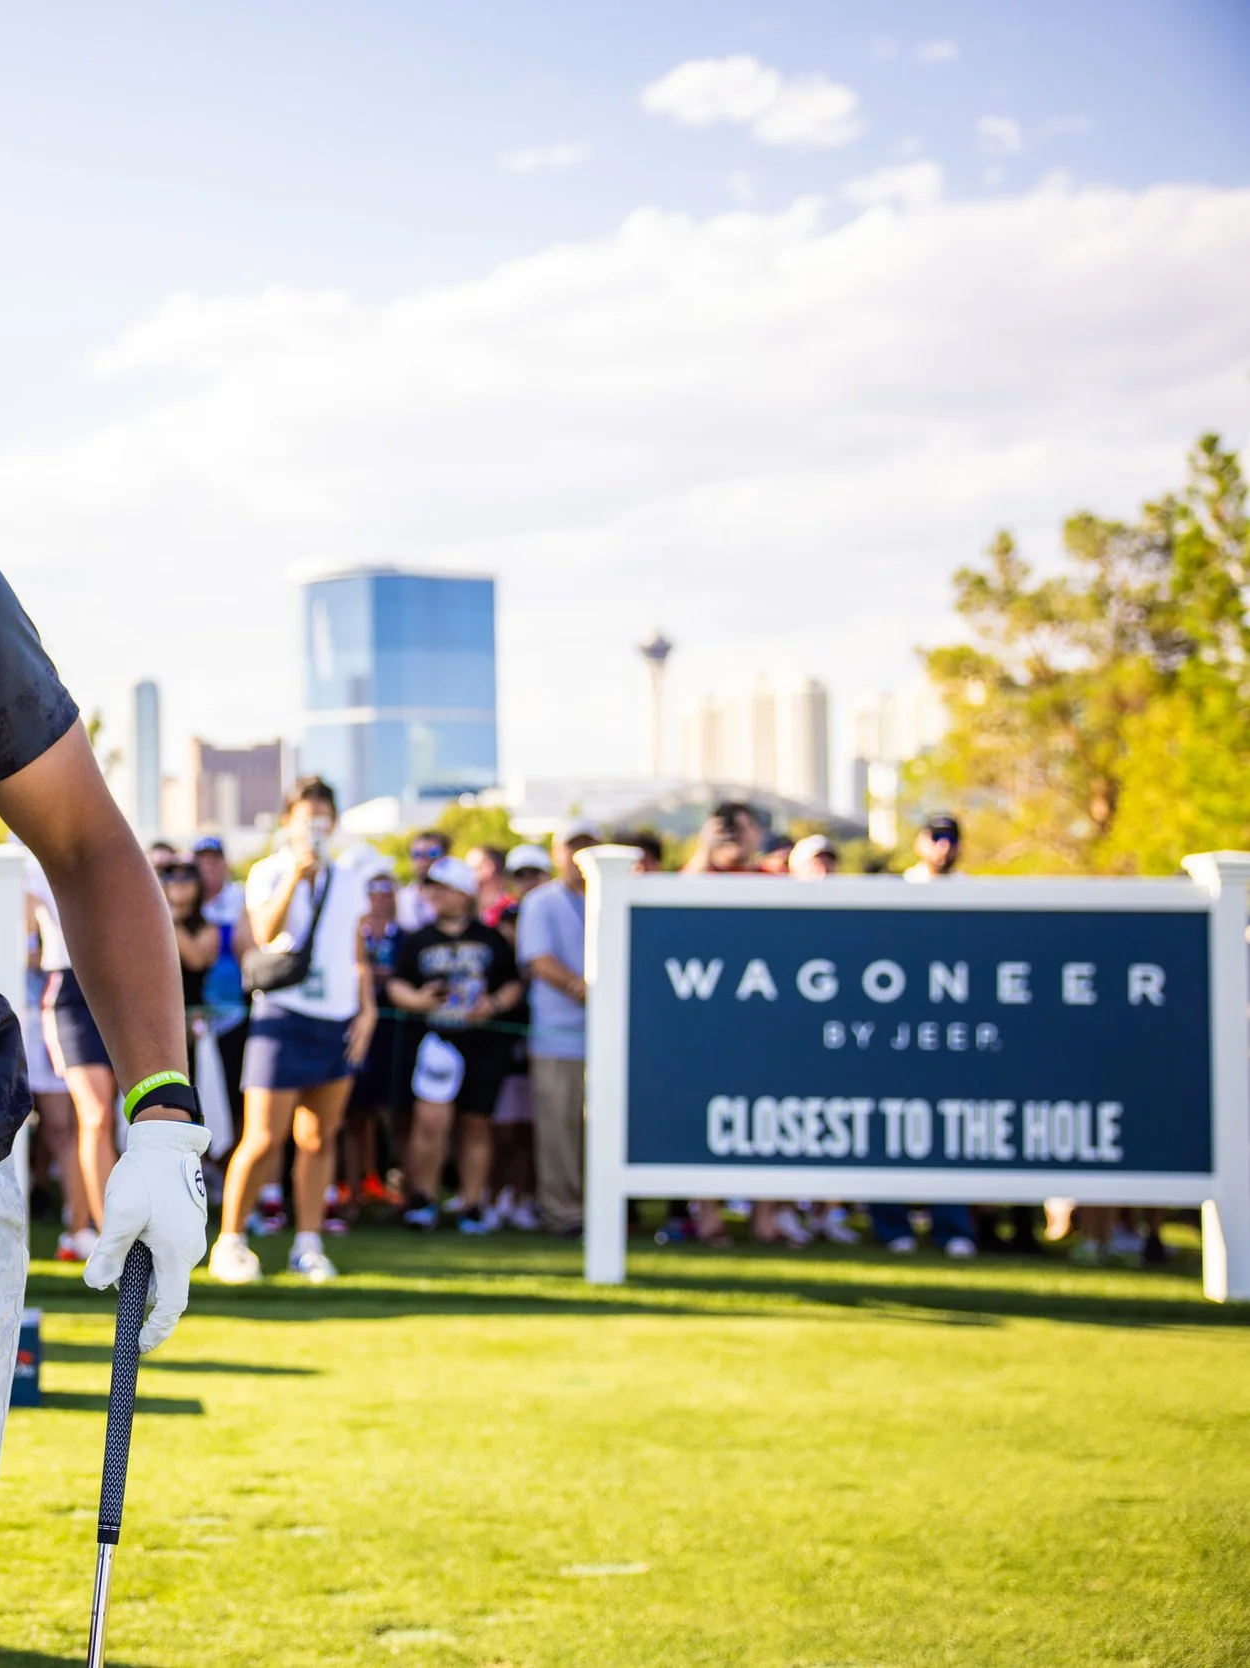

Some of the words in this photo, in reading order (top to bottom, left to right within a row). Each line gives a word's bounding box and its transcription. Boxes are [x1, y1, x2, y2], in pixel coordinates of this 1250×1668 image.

[664, 957, 1167, 1006] WAGONEER
[822, 1020, 876, 1050] BY
[706, 1095, 873, 1157] CLOSEST
[881, 1098, 933, 1160] TO
[937, 1099, 1017, 1161] THE
[1022, 1101, 1124, 1163] HOLE
